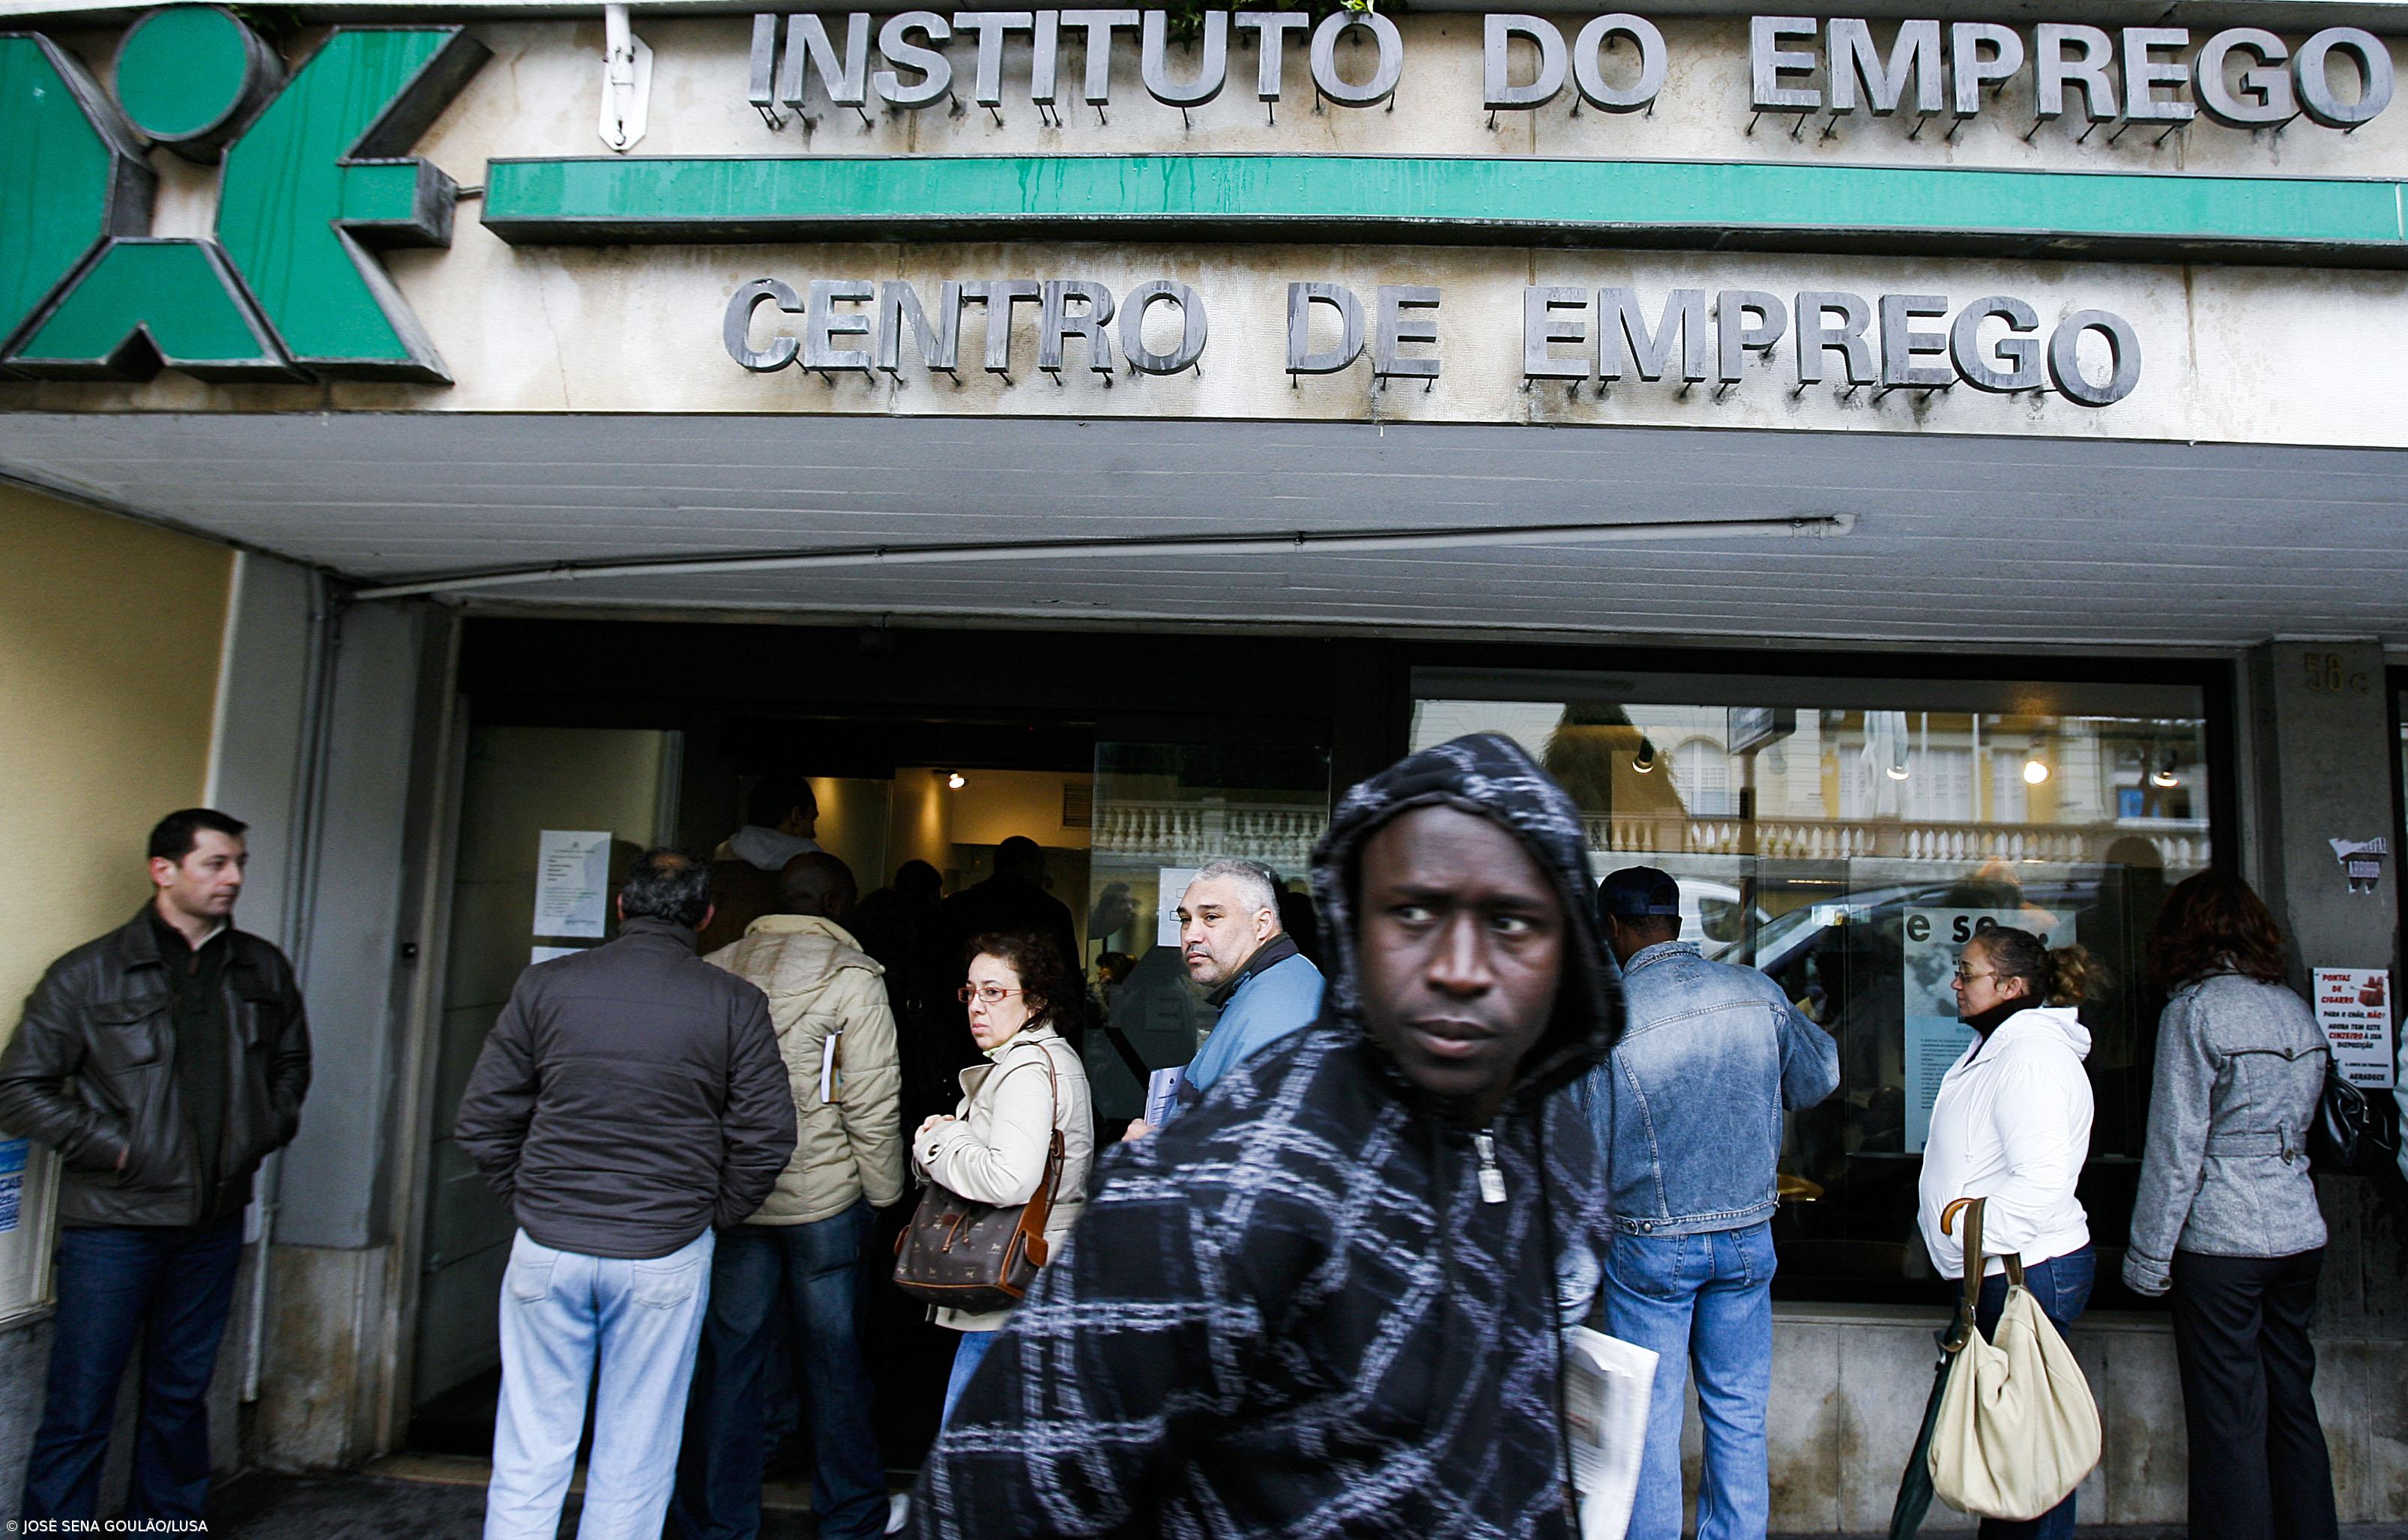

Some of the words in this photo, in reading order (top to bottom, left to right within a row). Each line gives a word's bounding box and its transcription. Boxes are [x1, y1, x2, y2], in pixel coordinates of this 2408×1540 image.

[749, 9, 1403, 109] INSTITUTO
[1483, 13, 1668, 113] DO
[1748, 16, 2393, 130] EMPREGO
[722, 277, 1208, 375] CENTRO
[1285, 281, 1440, 378] DE
[1524, 286, 2141, 408] EMPREGO
[1907, 914, 1931, 942] e
